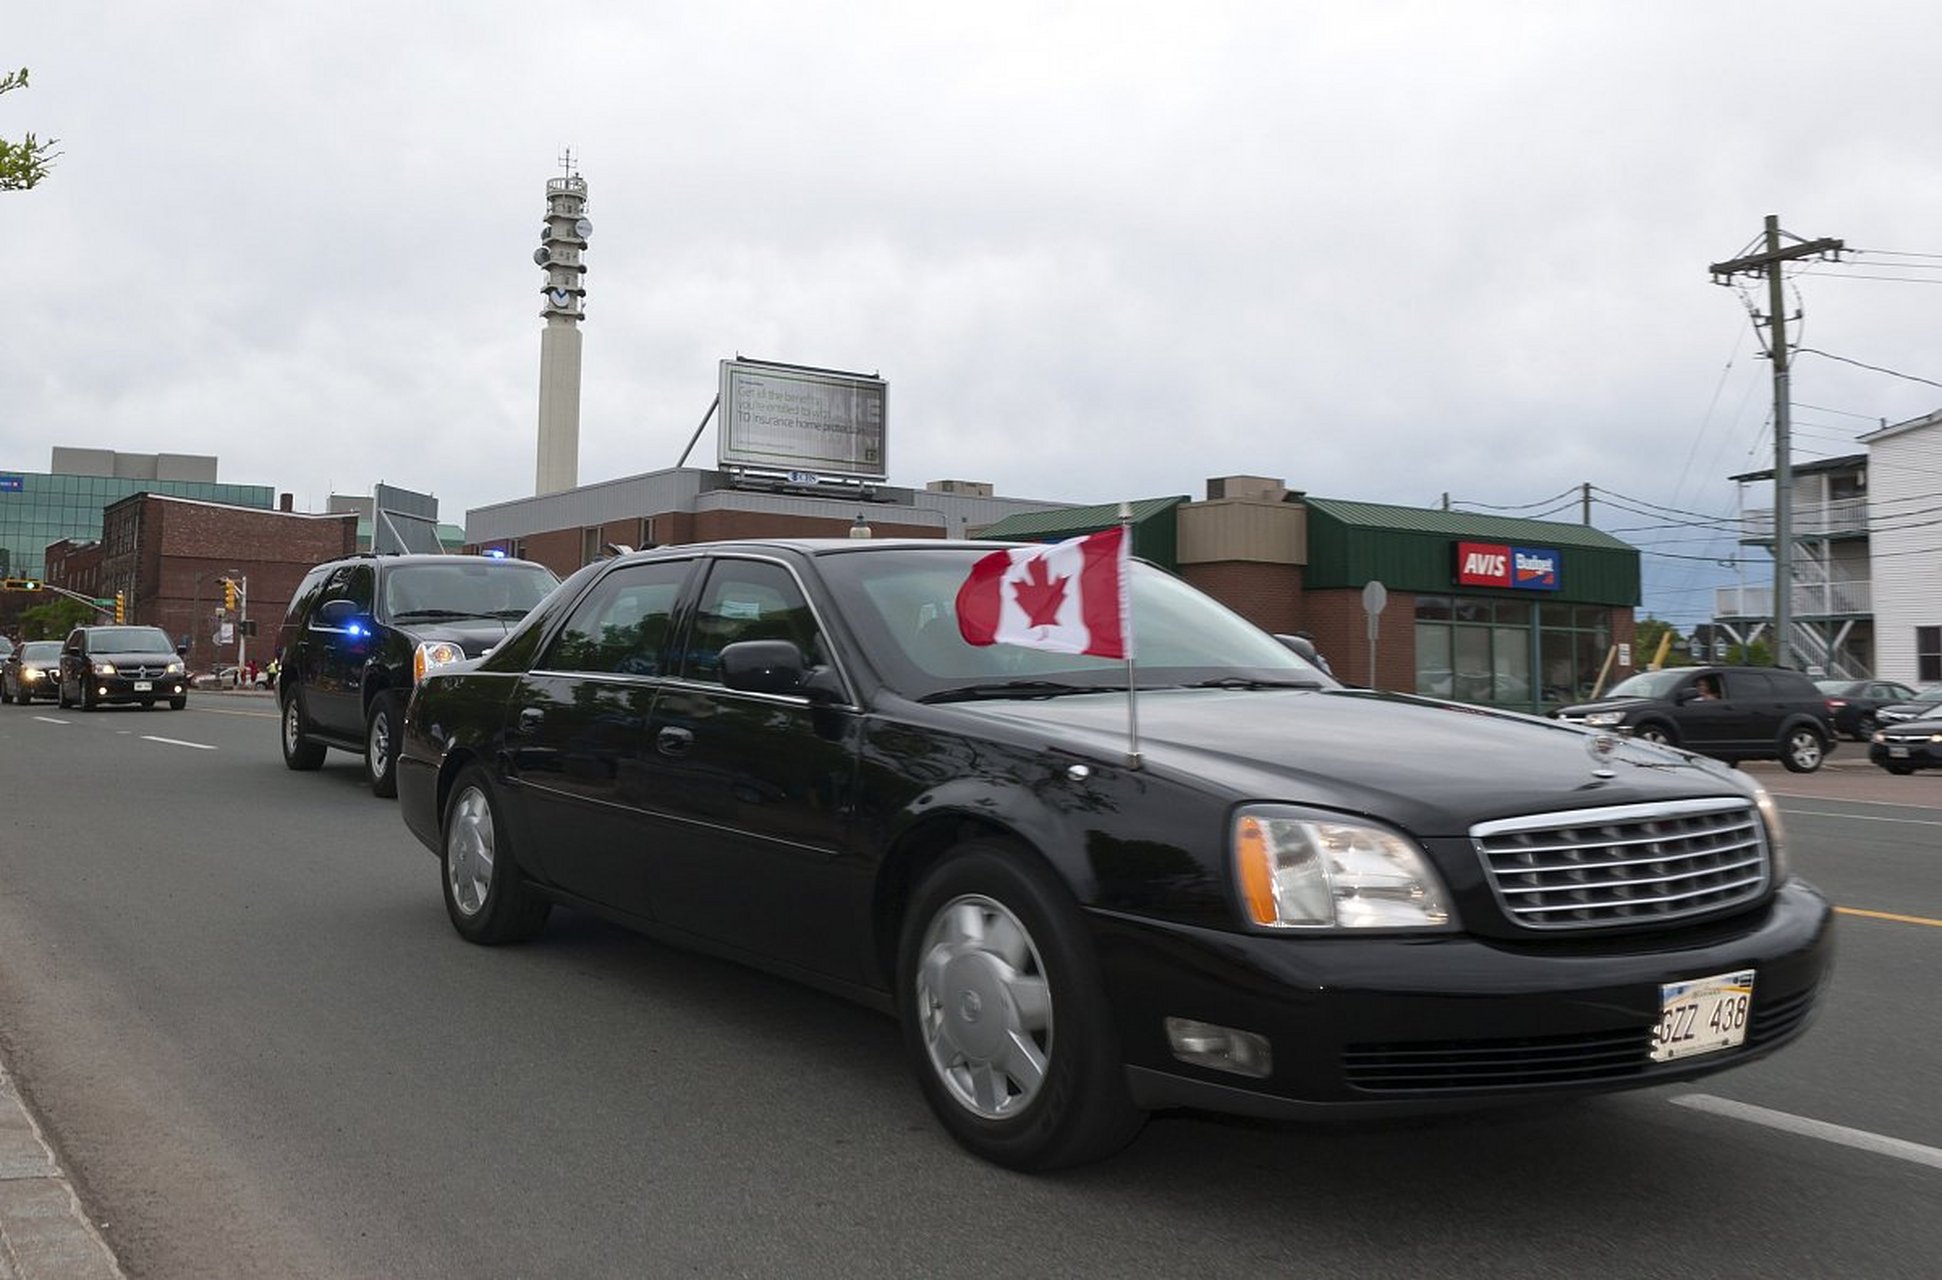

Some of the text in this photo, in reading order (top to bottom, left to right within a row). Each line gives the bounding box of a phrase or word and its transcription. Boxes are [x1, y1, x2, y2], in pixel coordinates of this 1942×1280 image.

[796, 418, 822, 432] home
[799, 473, 817, 483] CBS
[1464, 553, 1506, 576] AVIS
[1515, 553, 1554, 575] Budget
[1659, 996, 1747, 1044] GZZ 438
